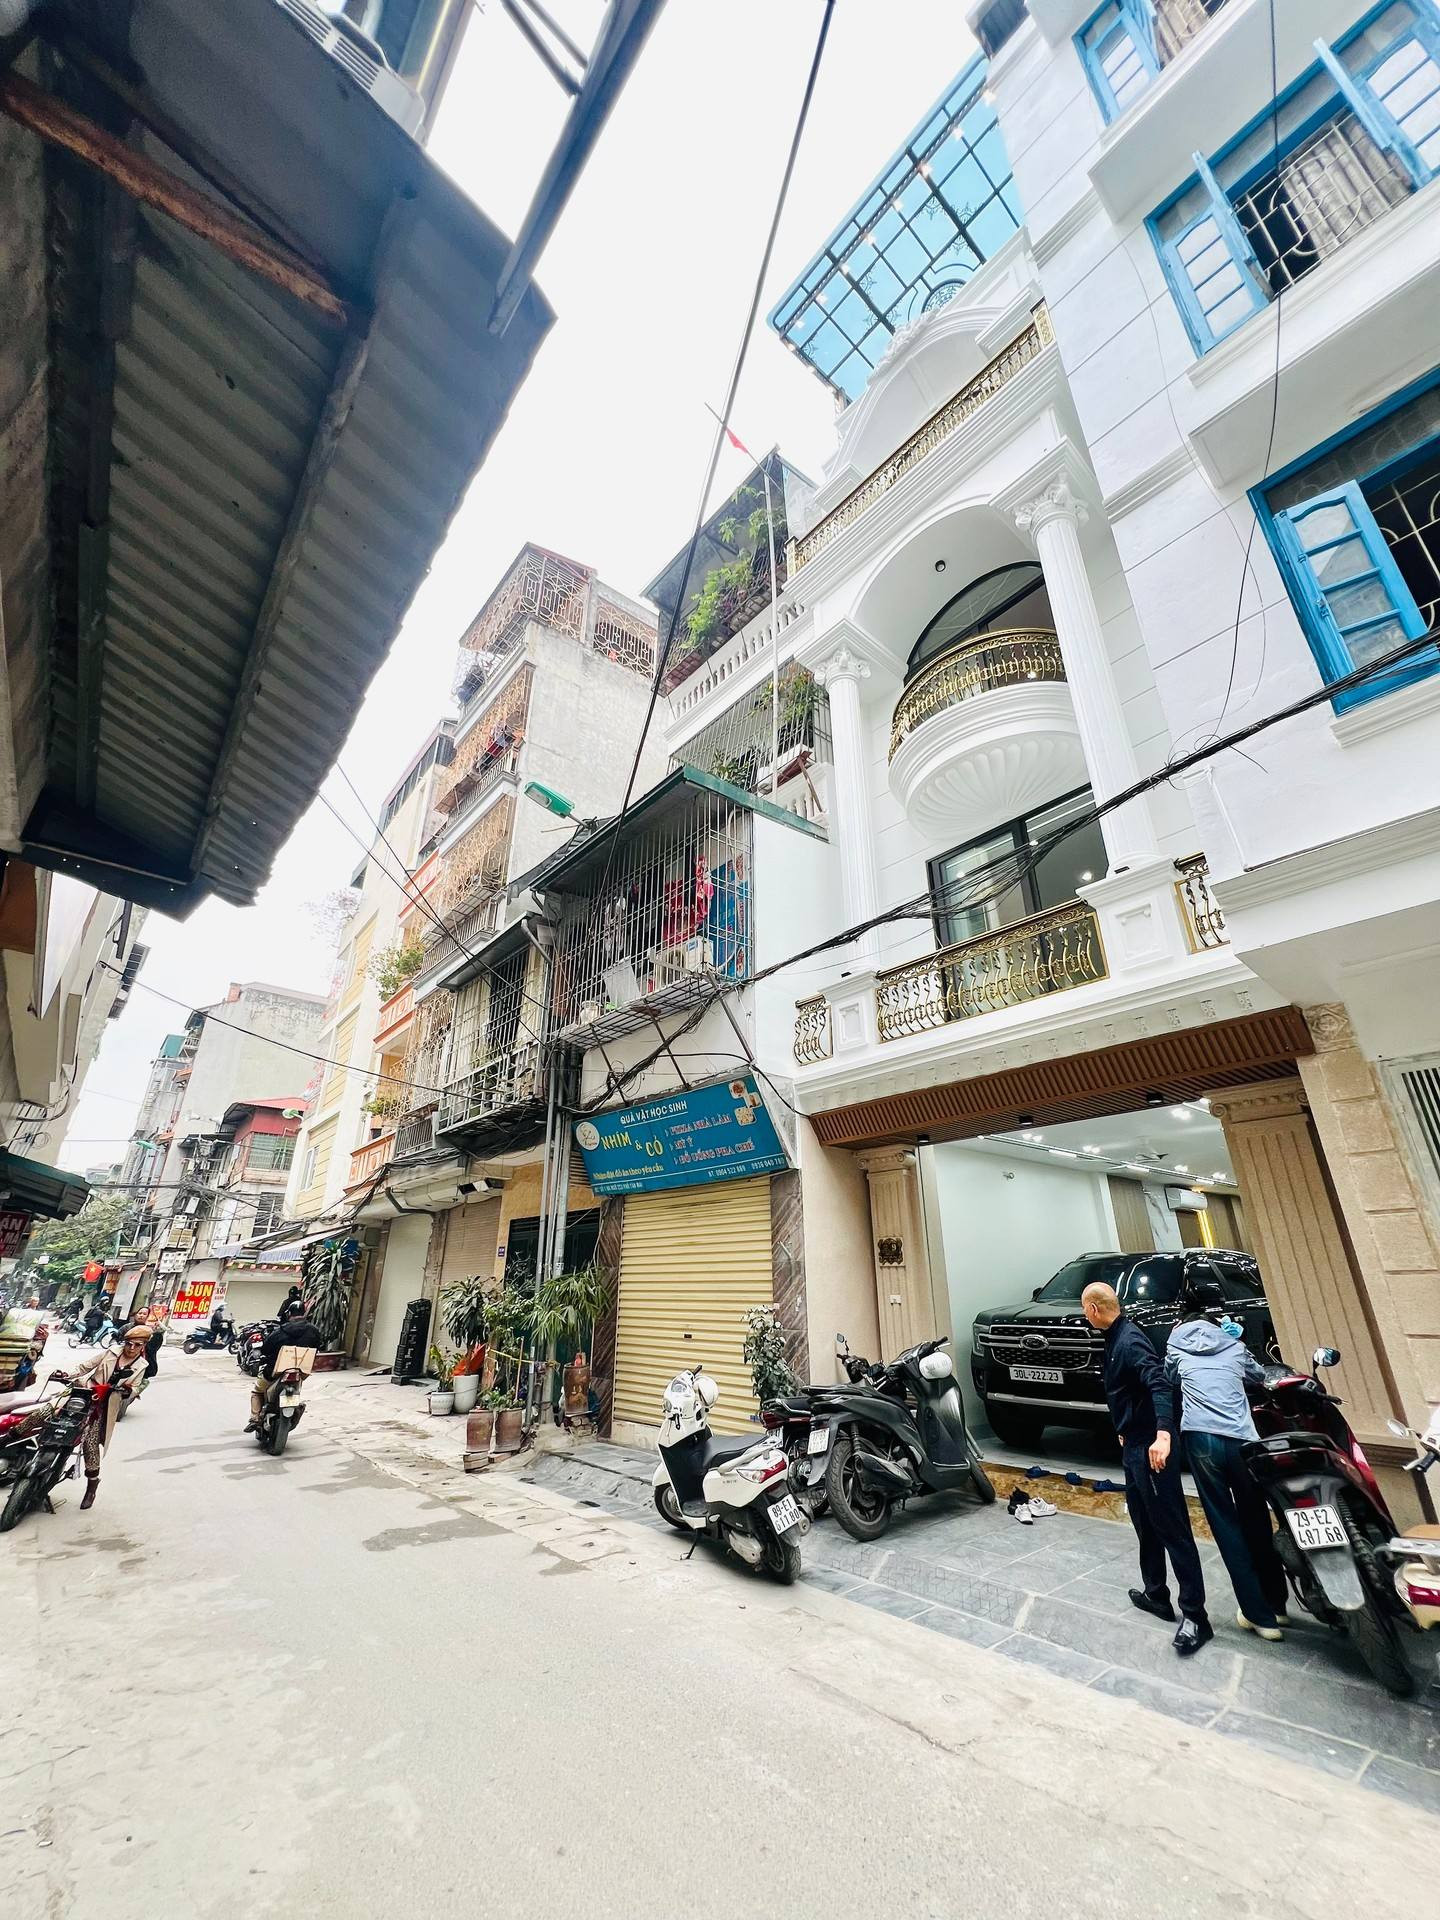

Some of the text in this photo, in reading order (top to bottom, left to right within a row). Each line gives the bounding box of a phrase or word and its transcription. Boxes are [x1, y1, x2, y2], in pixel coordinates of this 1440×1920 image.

[620, 1111, 635, 1124] QUÀ
[650, 1105, 667, 1119] HỌC
[669, 1100, 688, 1112] SINH
[601, 1130, 632, 1150] NHÍM
[635, 1140, 643, 1150] &
[185, 1282, 214, 1297] BÚN
[1013, 1369, 1059, 1381] 30L-222.23
[772, 1498, 792, 1518] 89-E1
[1293, 1509, 1332, 1527] 29-E2
[1298, 1526, 1344, 1545] 487.68
